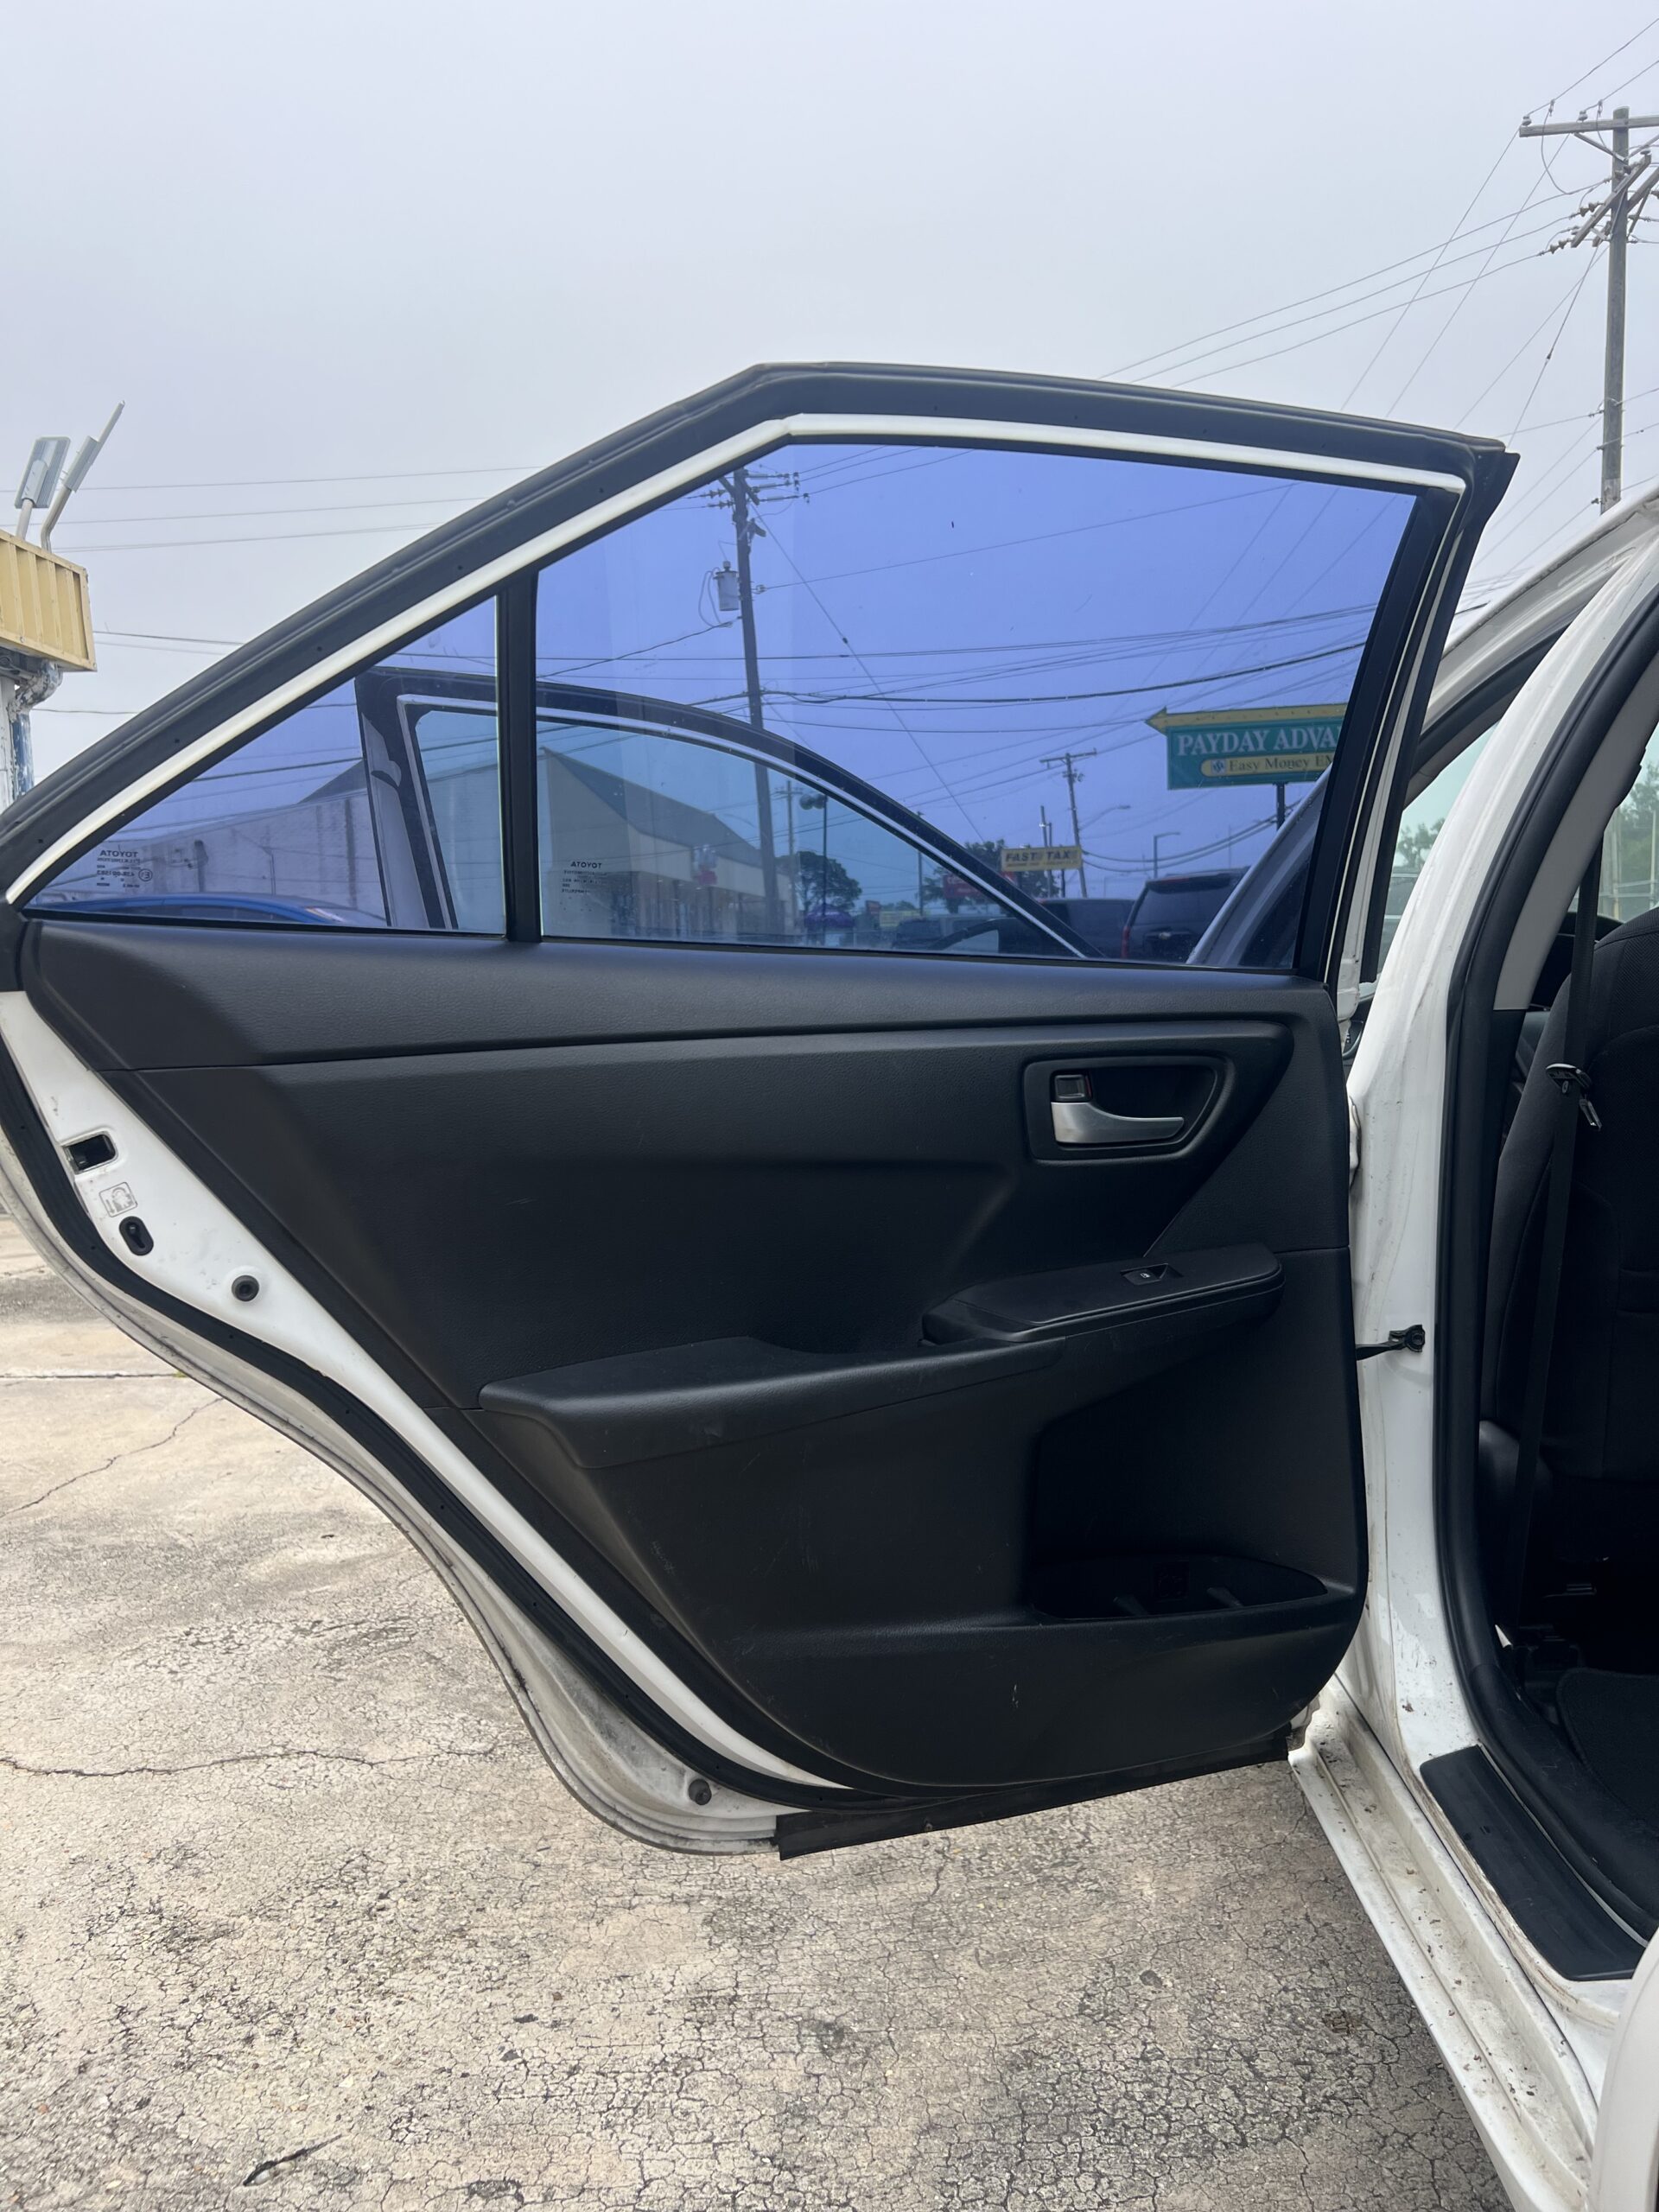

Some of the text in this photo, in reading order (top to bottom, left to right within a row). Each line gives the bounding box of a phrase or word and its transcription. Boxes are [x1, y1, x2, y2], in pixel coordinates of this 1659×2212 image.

[1178, 730, 1268, 756] PAYDAY
[1230, 760, 1261, 772] Easy
[1265, 757, 1309, 771] Money
[1046, 849, 1071, 860] TAX
